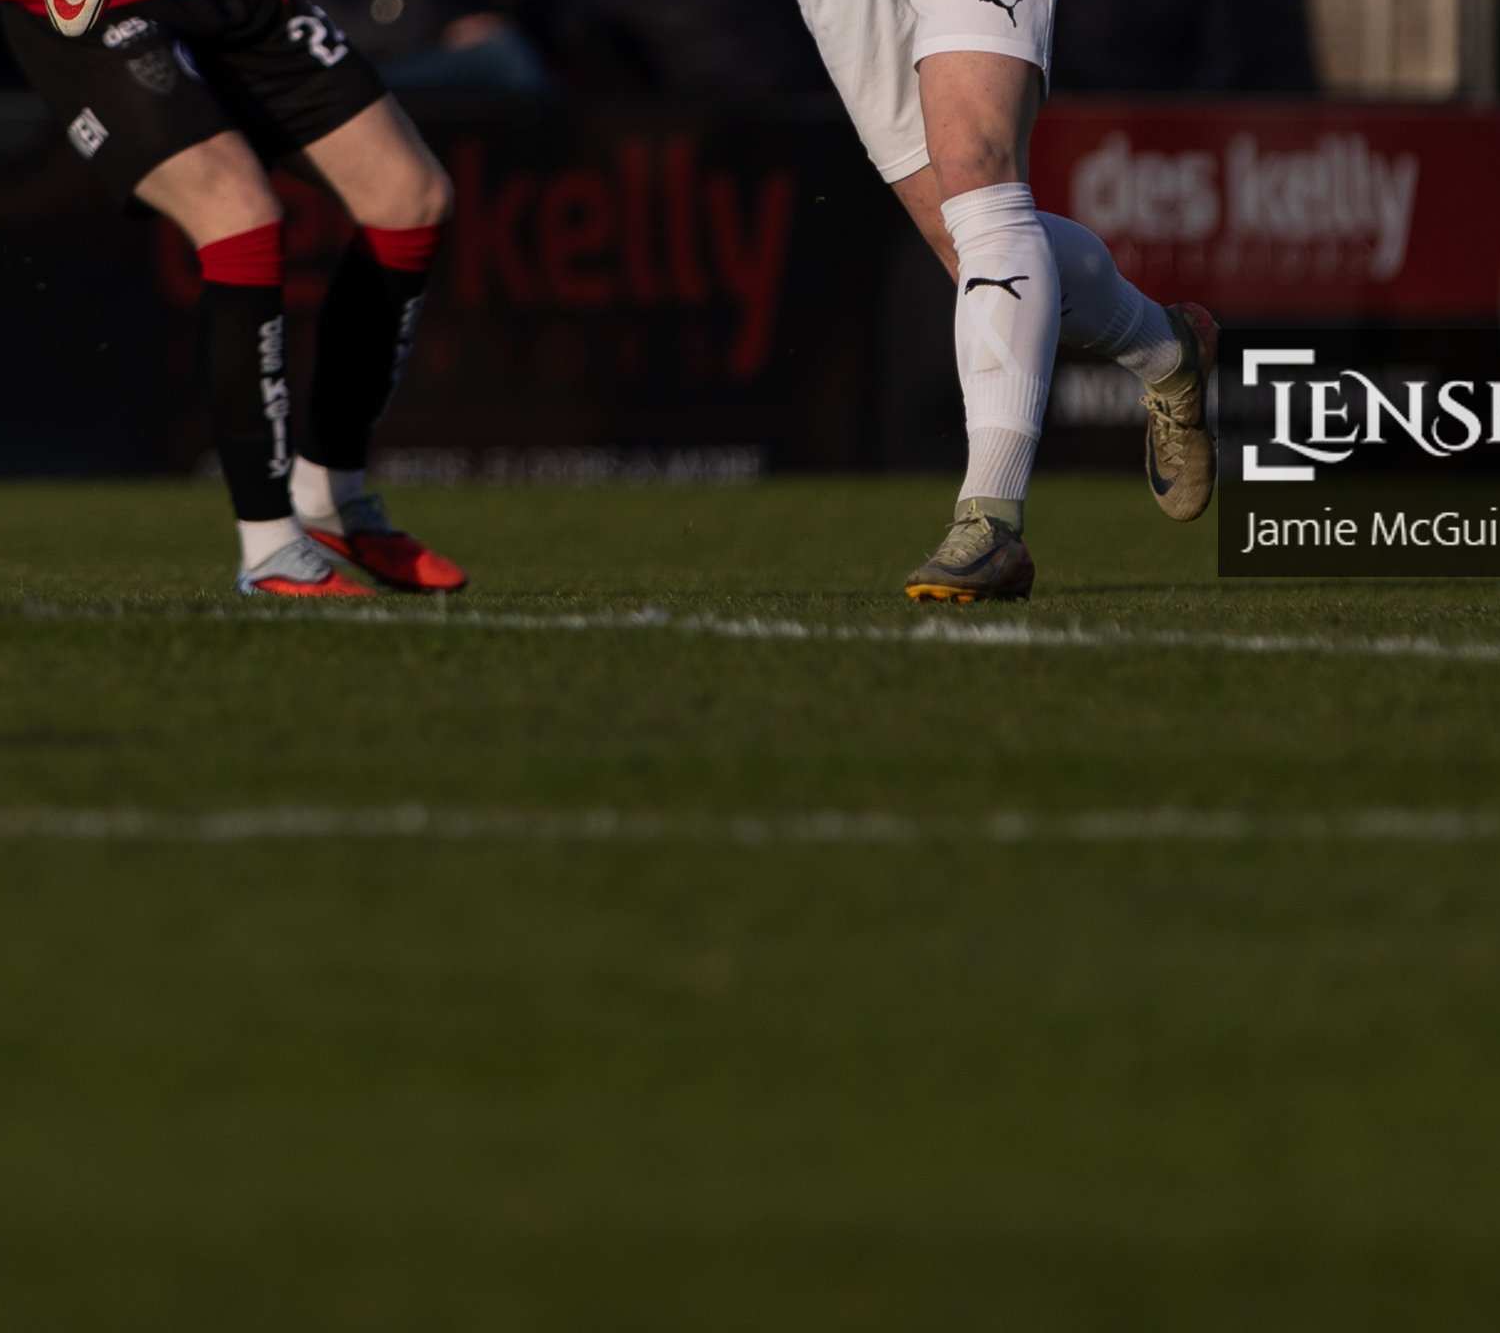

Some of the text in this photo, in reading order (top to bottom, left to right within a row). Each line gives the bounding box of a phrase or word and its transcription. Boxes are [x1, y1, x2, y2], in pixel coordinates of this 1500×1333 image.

[452, 138, 797, 380] kelly
[1070, 129, 1421, 283] des kelly
